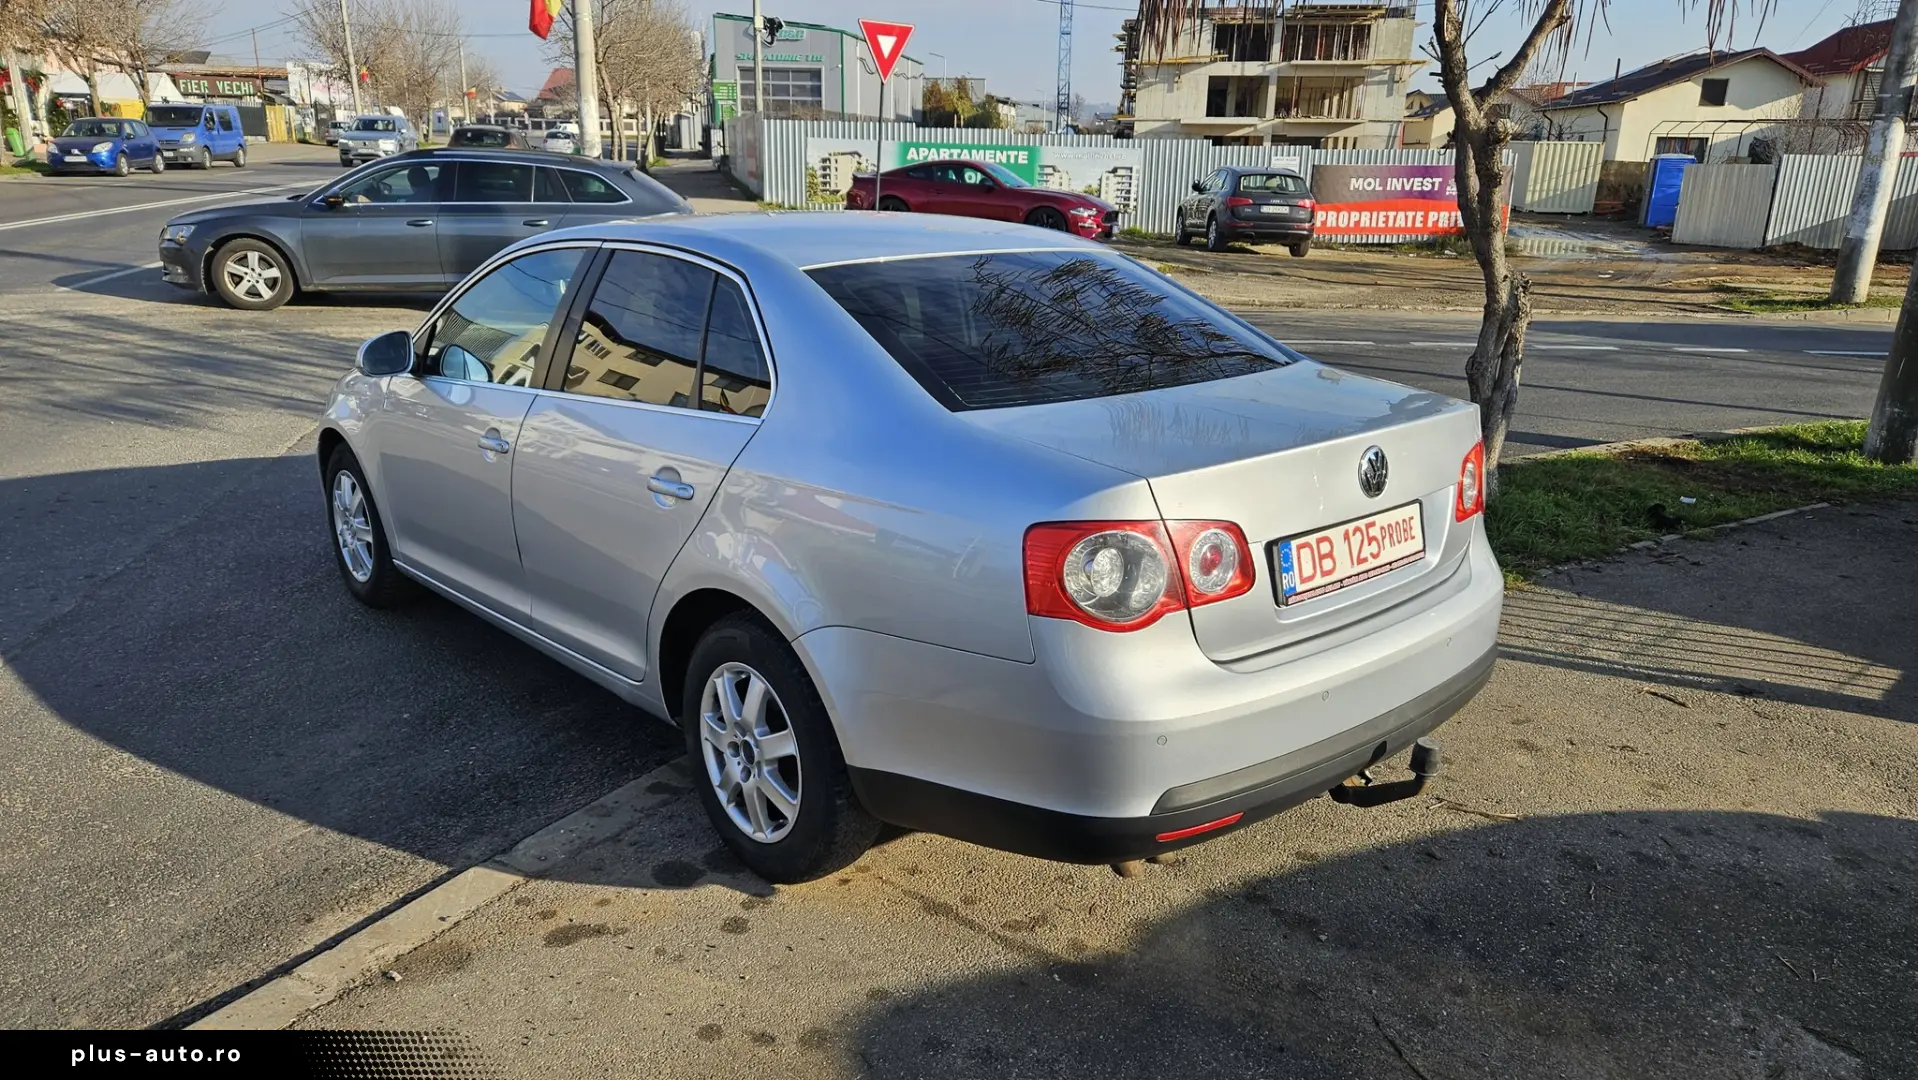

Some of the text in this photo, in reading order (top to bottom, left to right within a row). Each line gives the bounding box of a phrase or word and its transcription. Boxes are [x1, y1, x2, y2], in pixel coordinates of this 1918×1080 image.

[906, 147, 1028, 164] APARTAMENTE
[1350, 177, 1442, 191] MOL INVEST
[1316, 210, 1424, 228] PROPRIETATE
[1296, 535, 1337, 584] DB
[1282, 572, 1295, 589] RO
